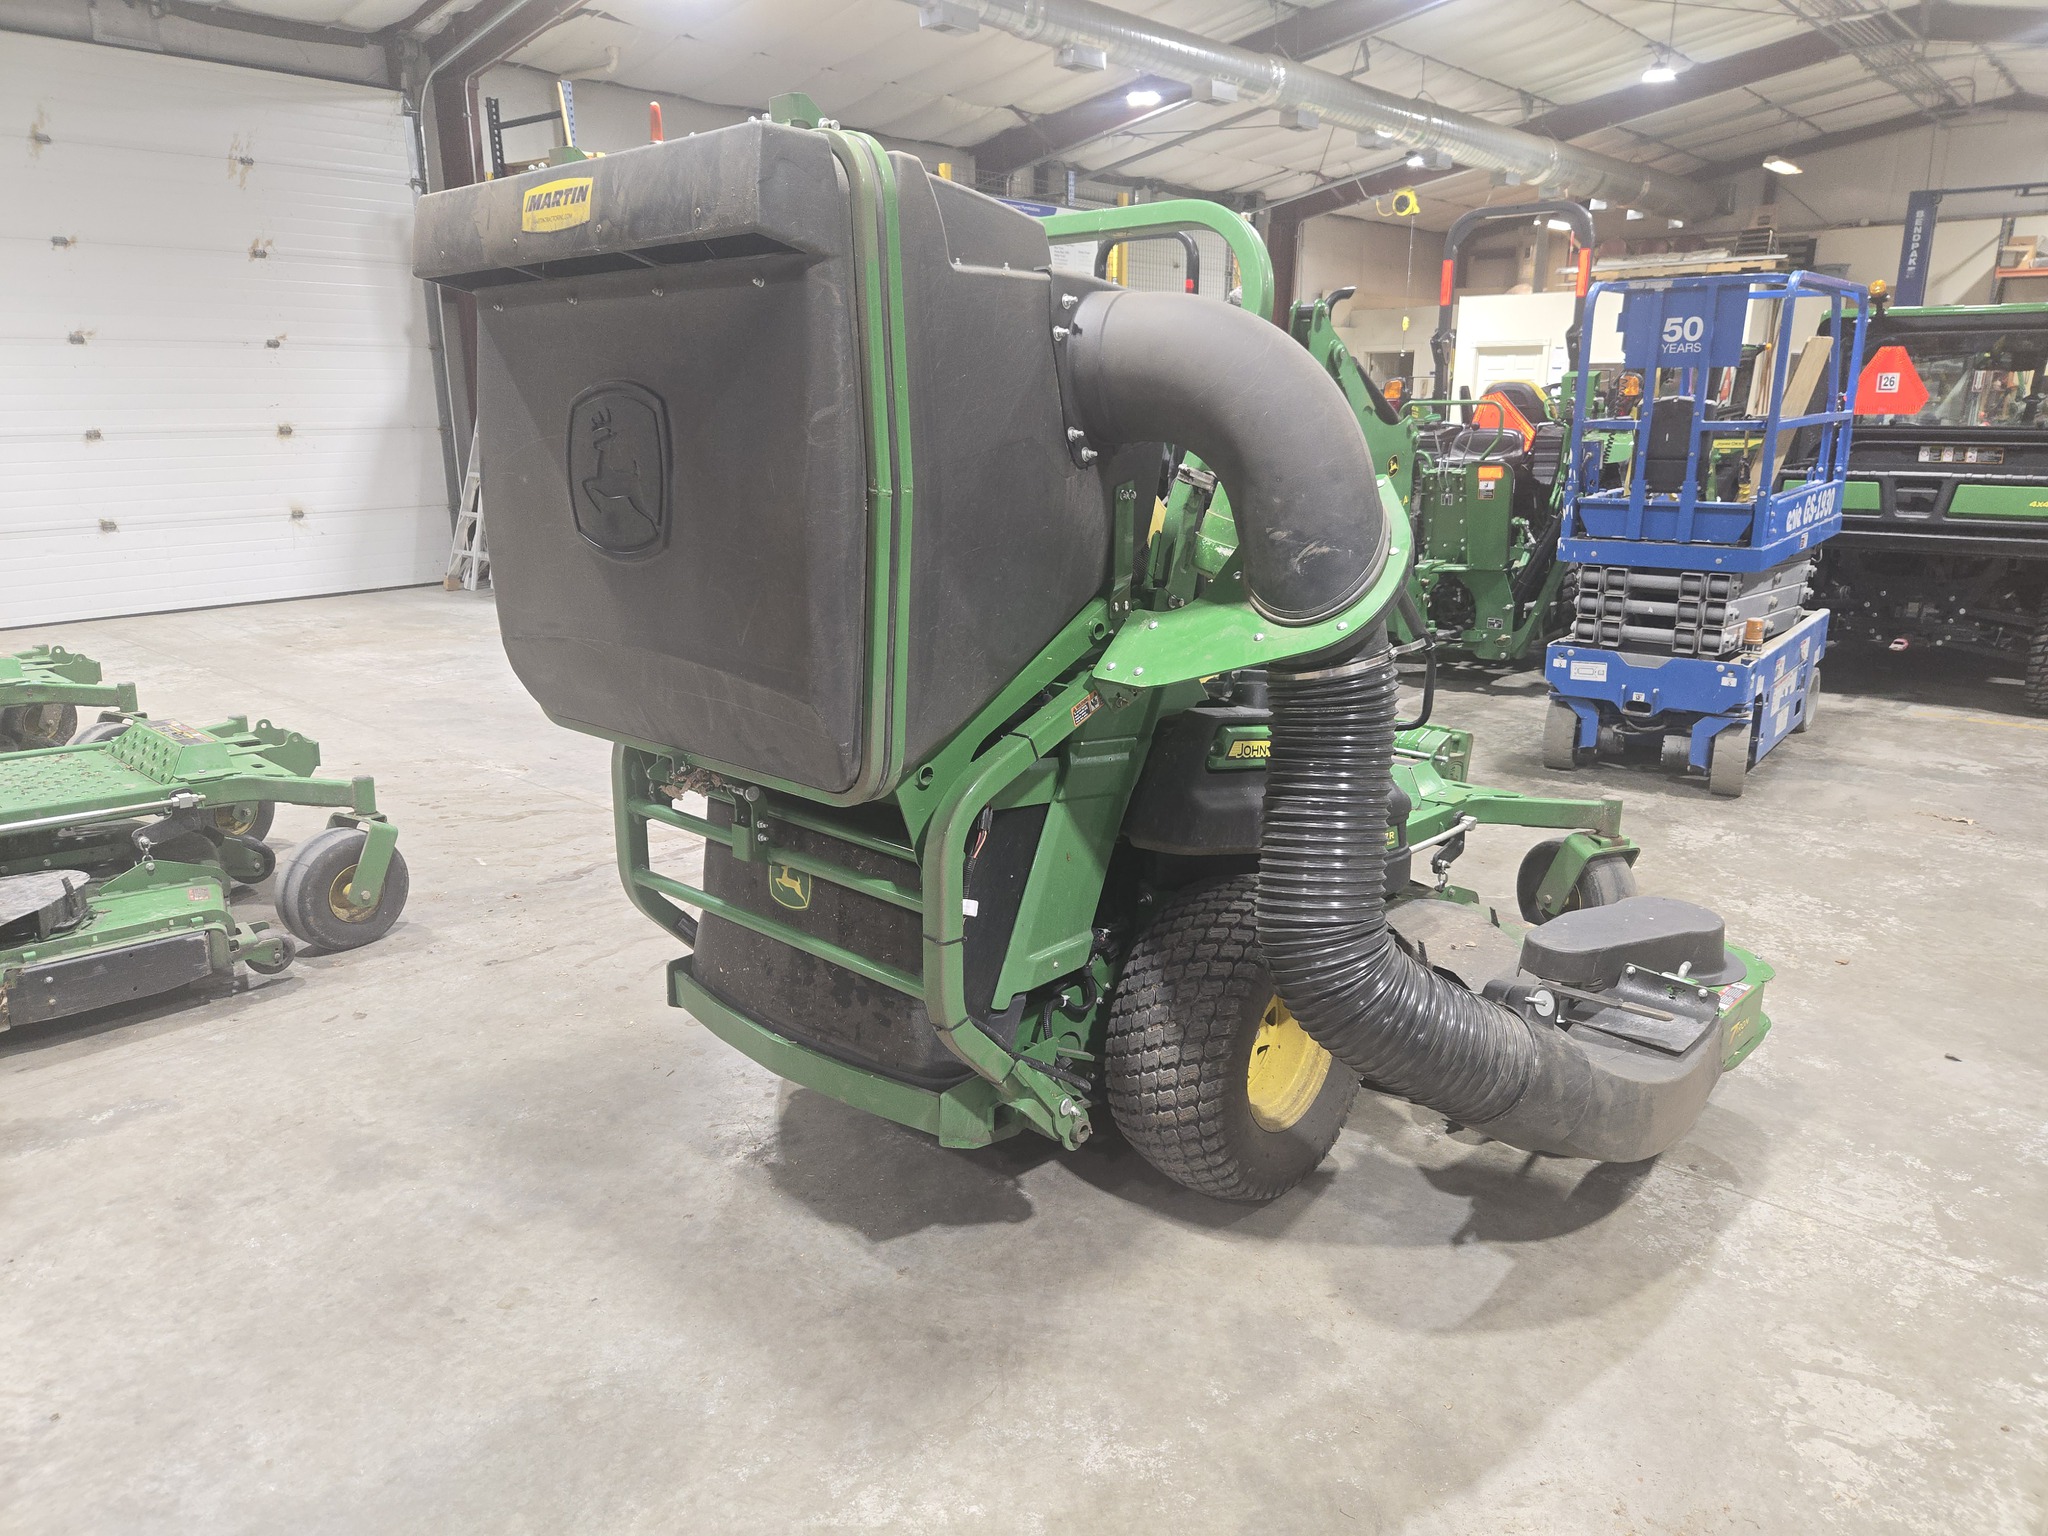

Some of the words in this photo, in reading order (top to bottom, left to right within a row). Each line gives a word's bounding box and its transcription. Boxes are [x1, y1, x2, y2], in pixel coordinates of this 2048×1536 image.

[525, 184, 590, 212] MARTIN
[1662, 316, 1704, 342] 50
[1661, 342, 1702, 354] YEARS
[1883, 376, 1895, 387] 26
[1803, 487, 1836, 525] GS-1930
[1237, 743, 1267, 757] JOHN
